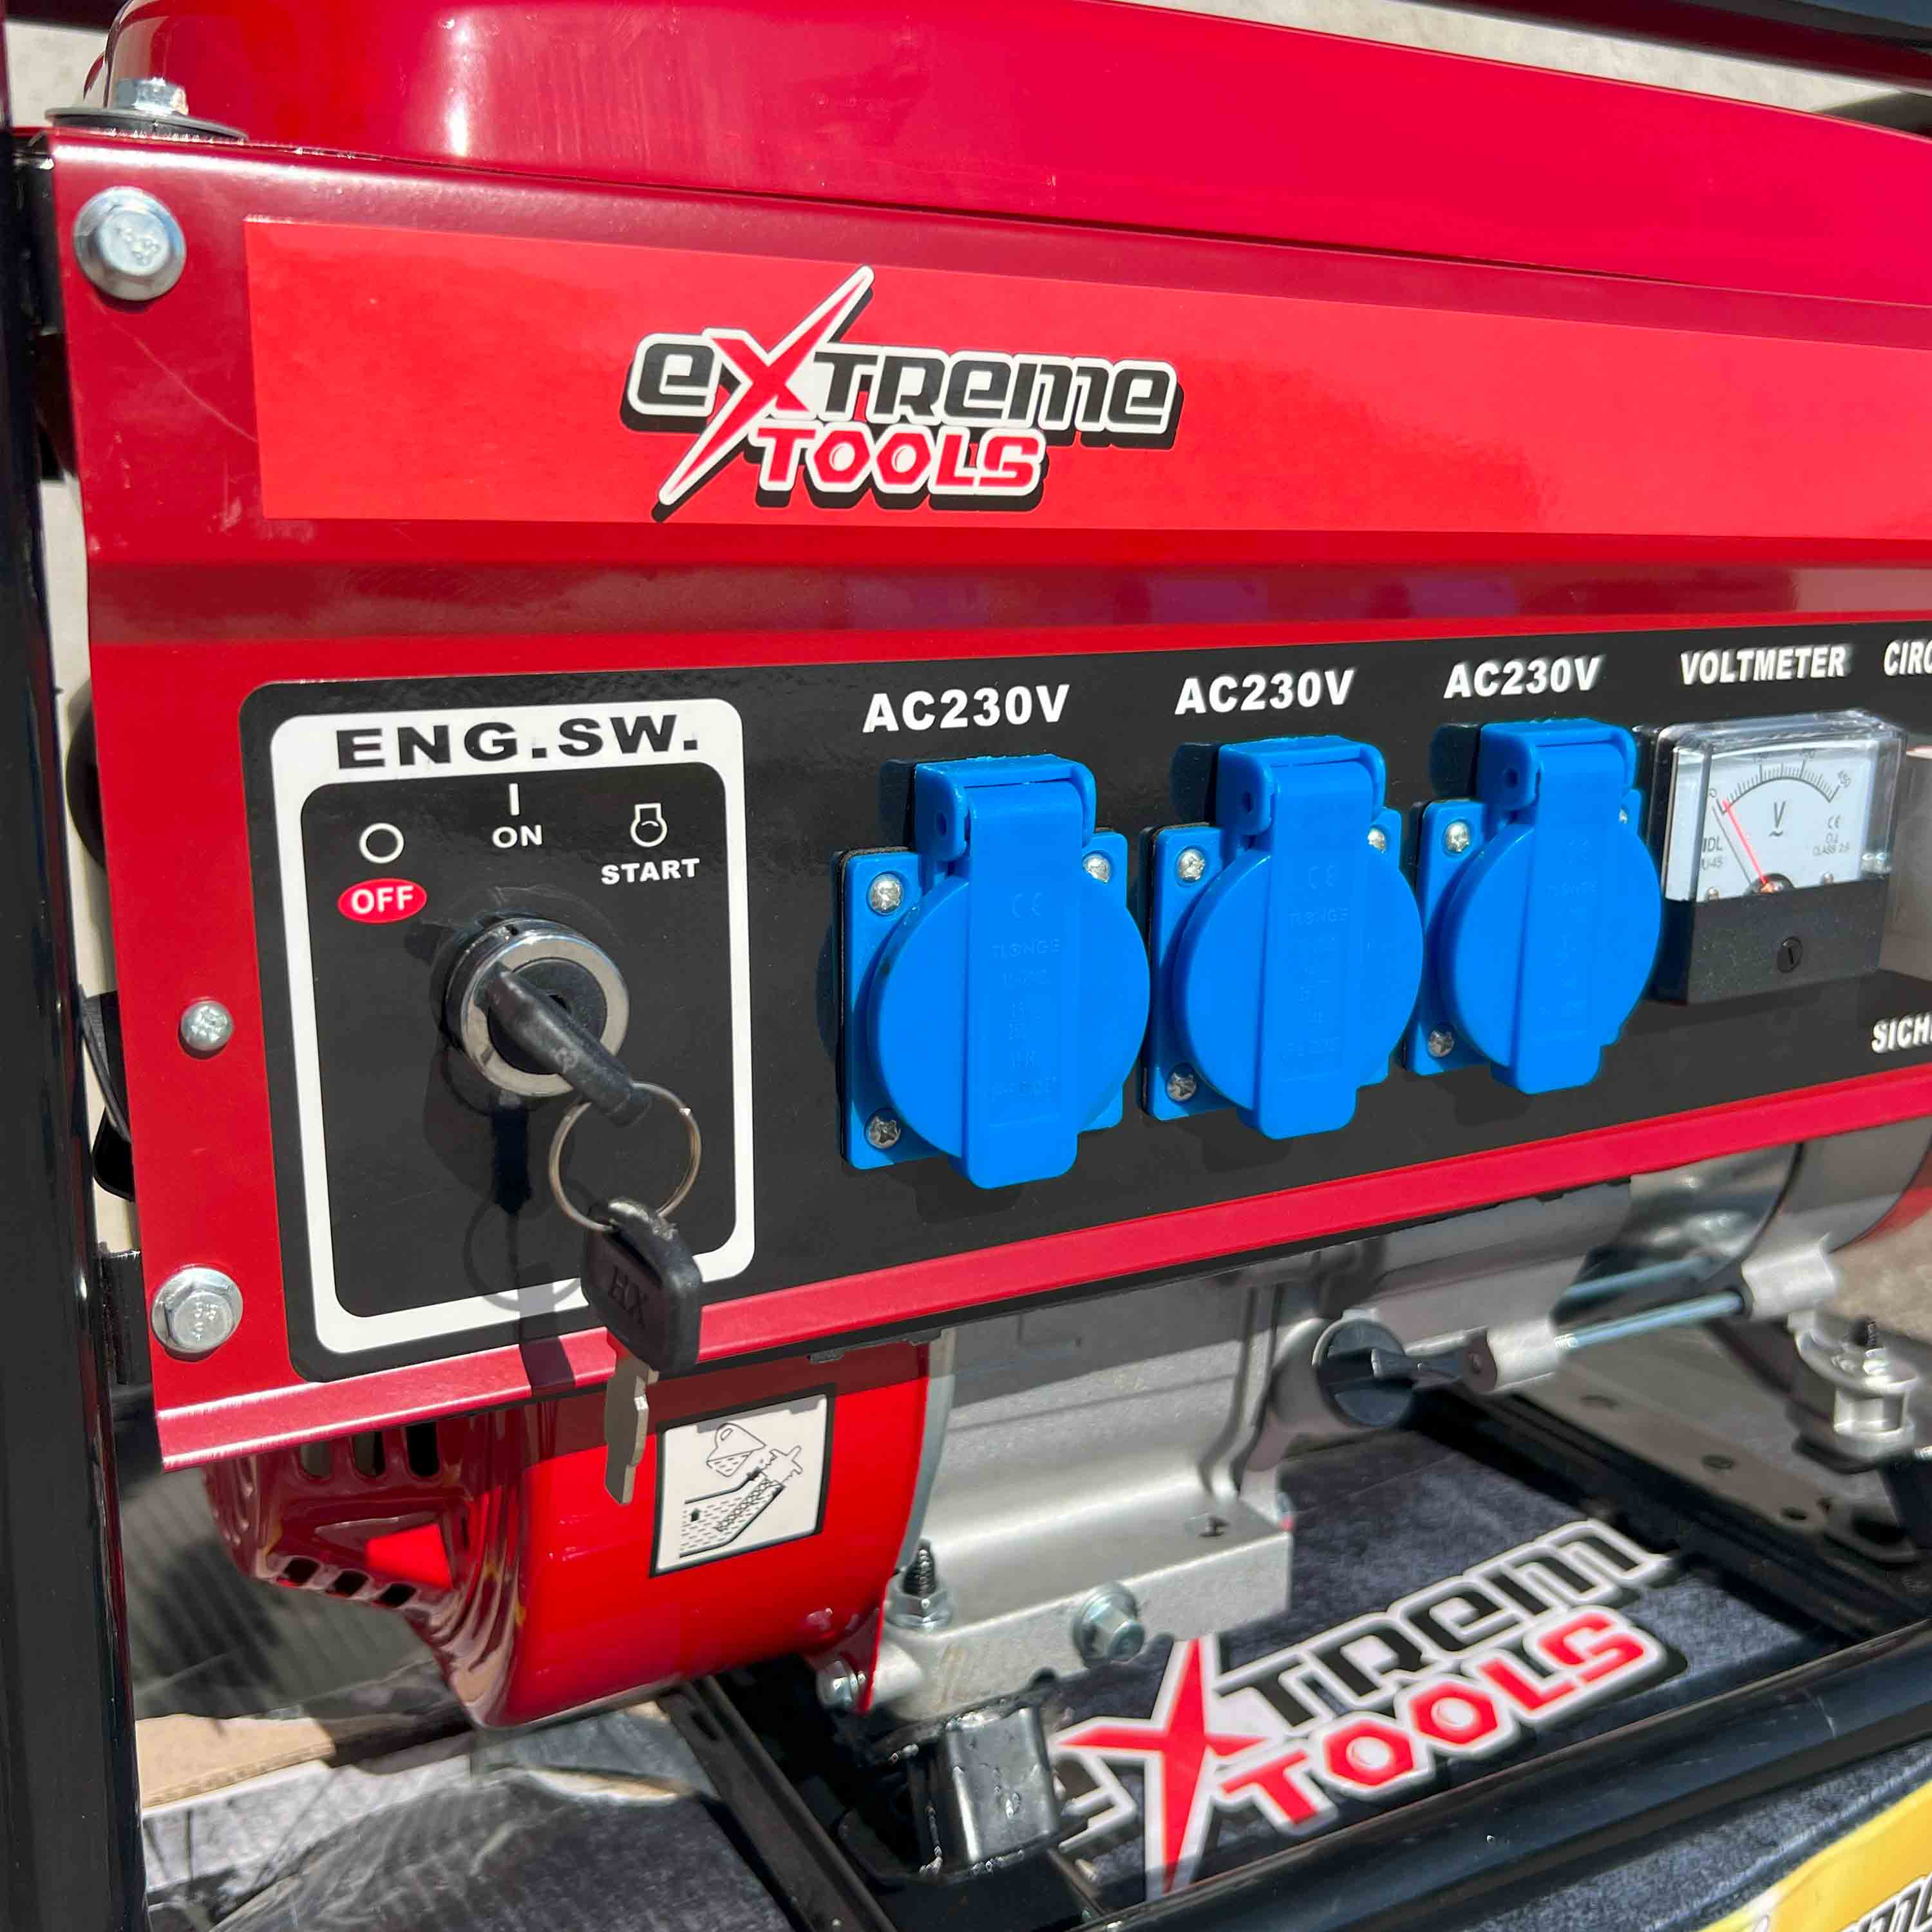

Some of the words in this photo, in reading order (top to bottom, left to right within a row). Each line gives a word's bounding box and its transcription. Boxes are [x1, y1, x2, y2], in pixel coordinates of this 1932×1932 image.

[752, 423, 1047, 507] TOOLS
[1443, 655, 1602, 699] AC230V
[1680, 644, 1848, 685] VOLTMETER
[862, 683, 1070, 734] AC230V
[1174, 668, 1356, 715] AC230V
[336, 714, 699, 770] ENG.SW.
[1773, 800, 1787, 829] V
[492, 824, 543, 849] ON
[601, 857, 701, 885] START
[350, 886, 414, 914] OFF
[1871, 1012, 1932, 1054] SICH
[1213, 1605, 1668, 1832] TOOLS
